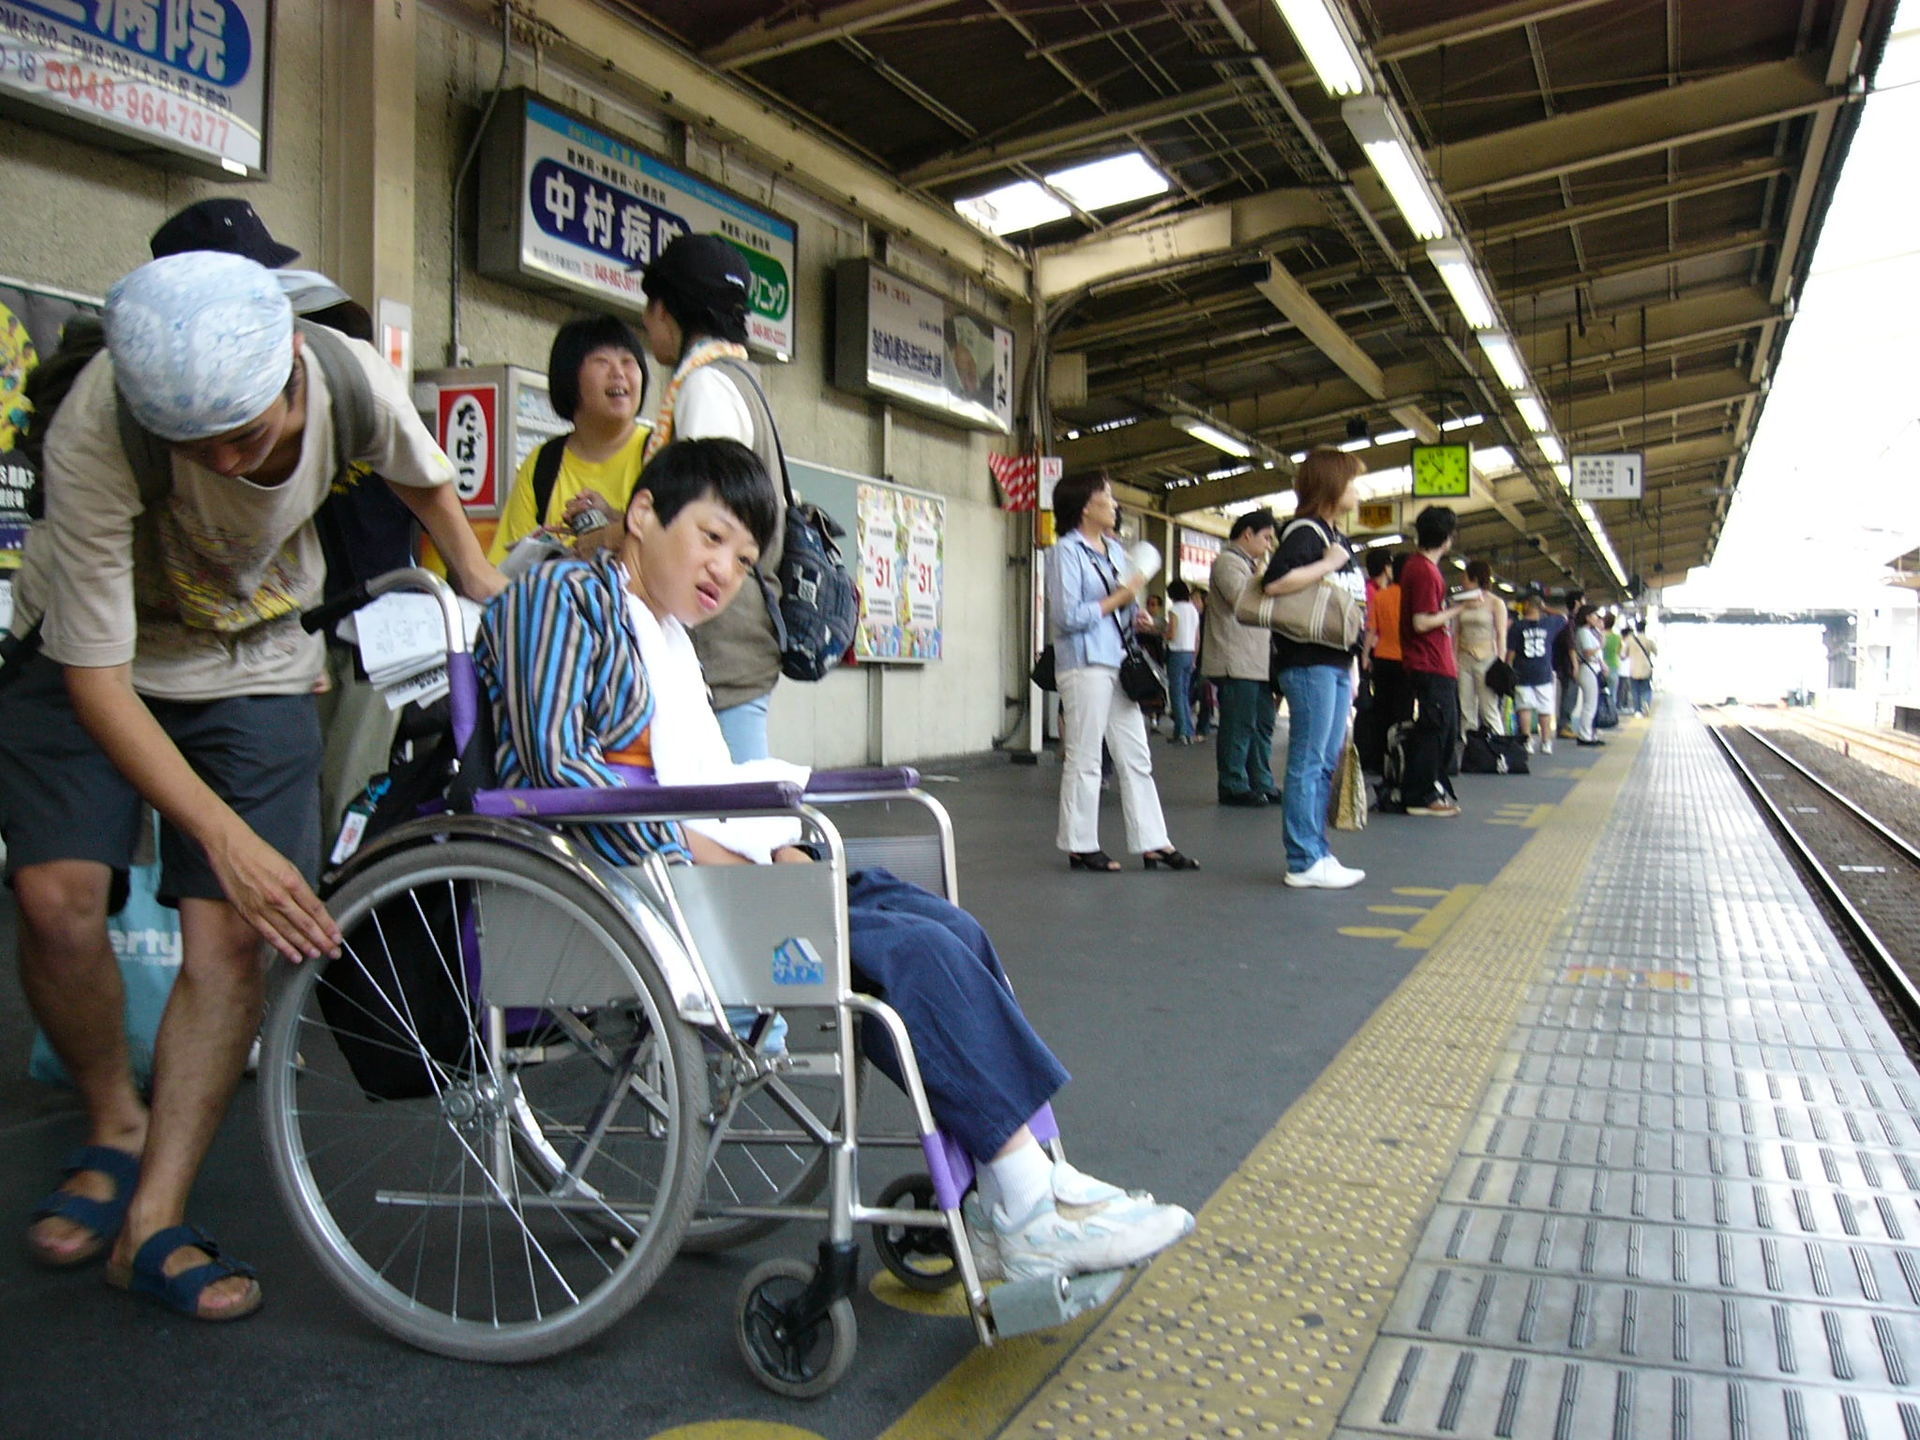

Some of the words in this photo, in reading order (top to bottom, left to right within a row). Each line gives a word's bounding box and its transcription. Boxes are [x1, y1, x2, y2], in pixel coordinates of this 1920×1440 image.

[1626, 466, 1634, 486] 1
[875, 556, 890, 589] 31
[918, 563, 932, 594] 31
